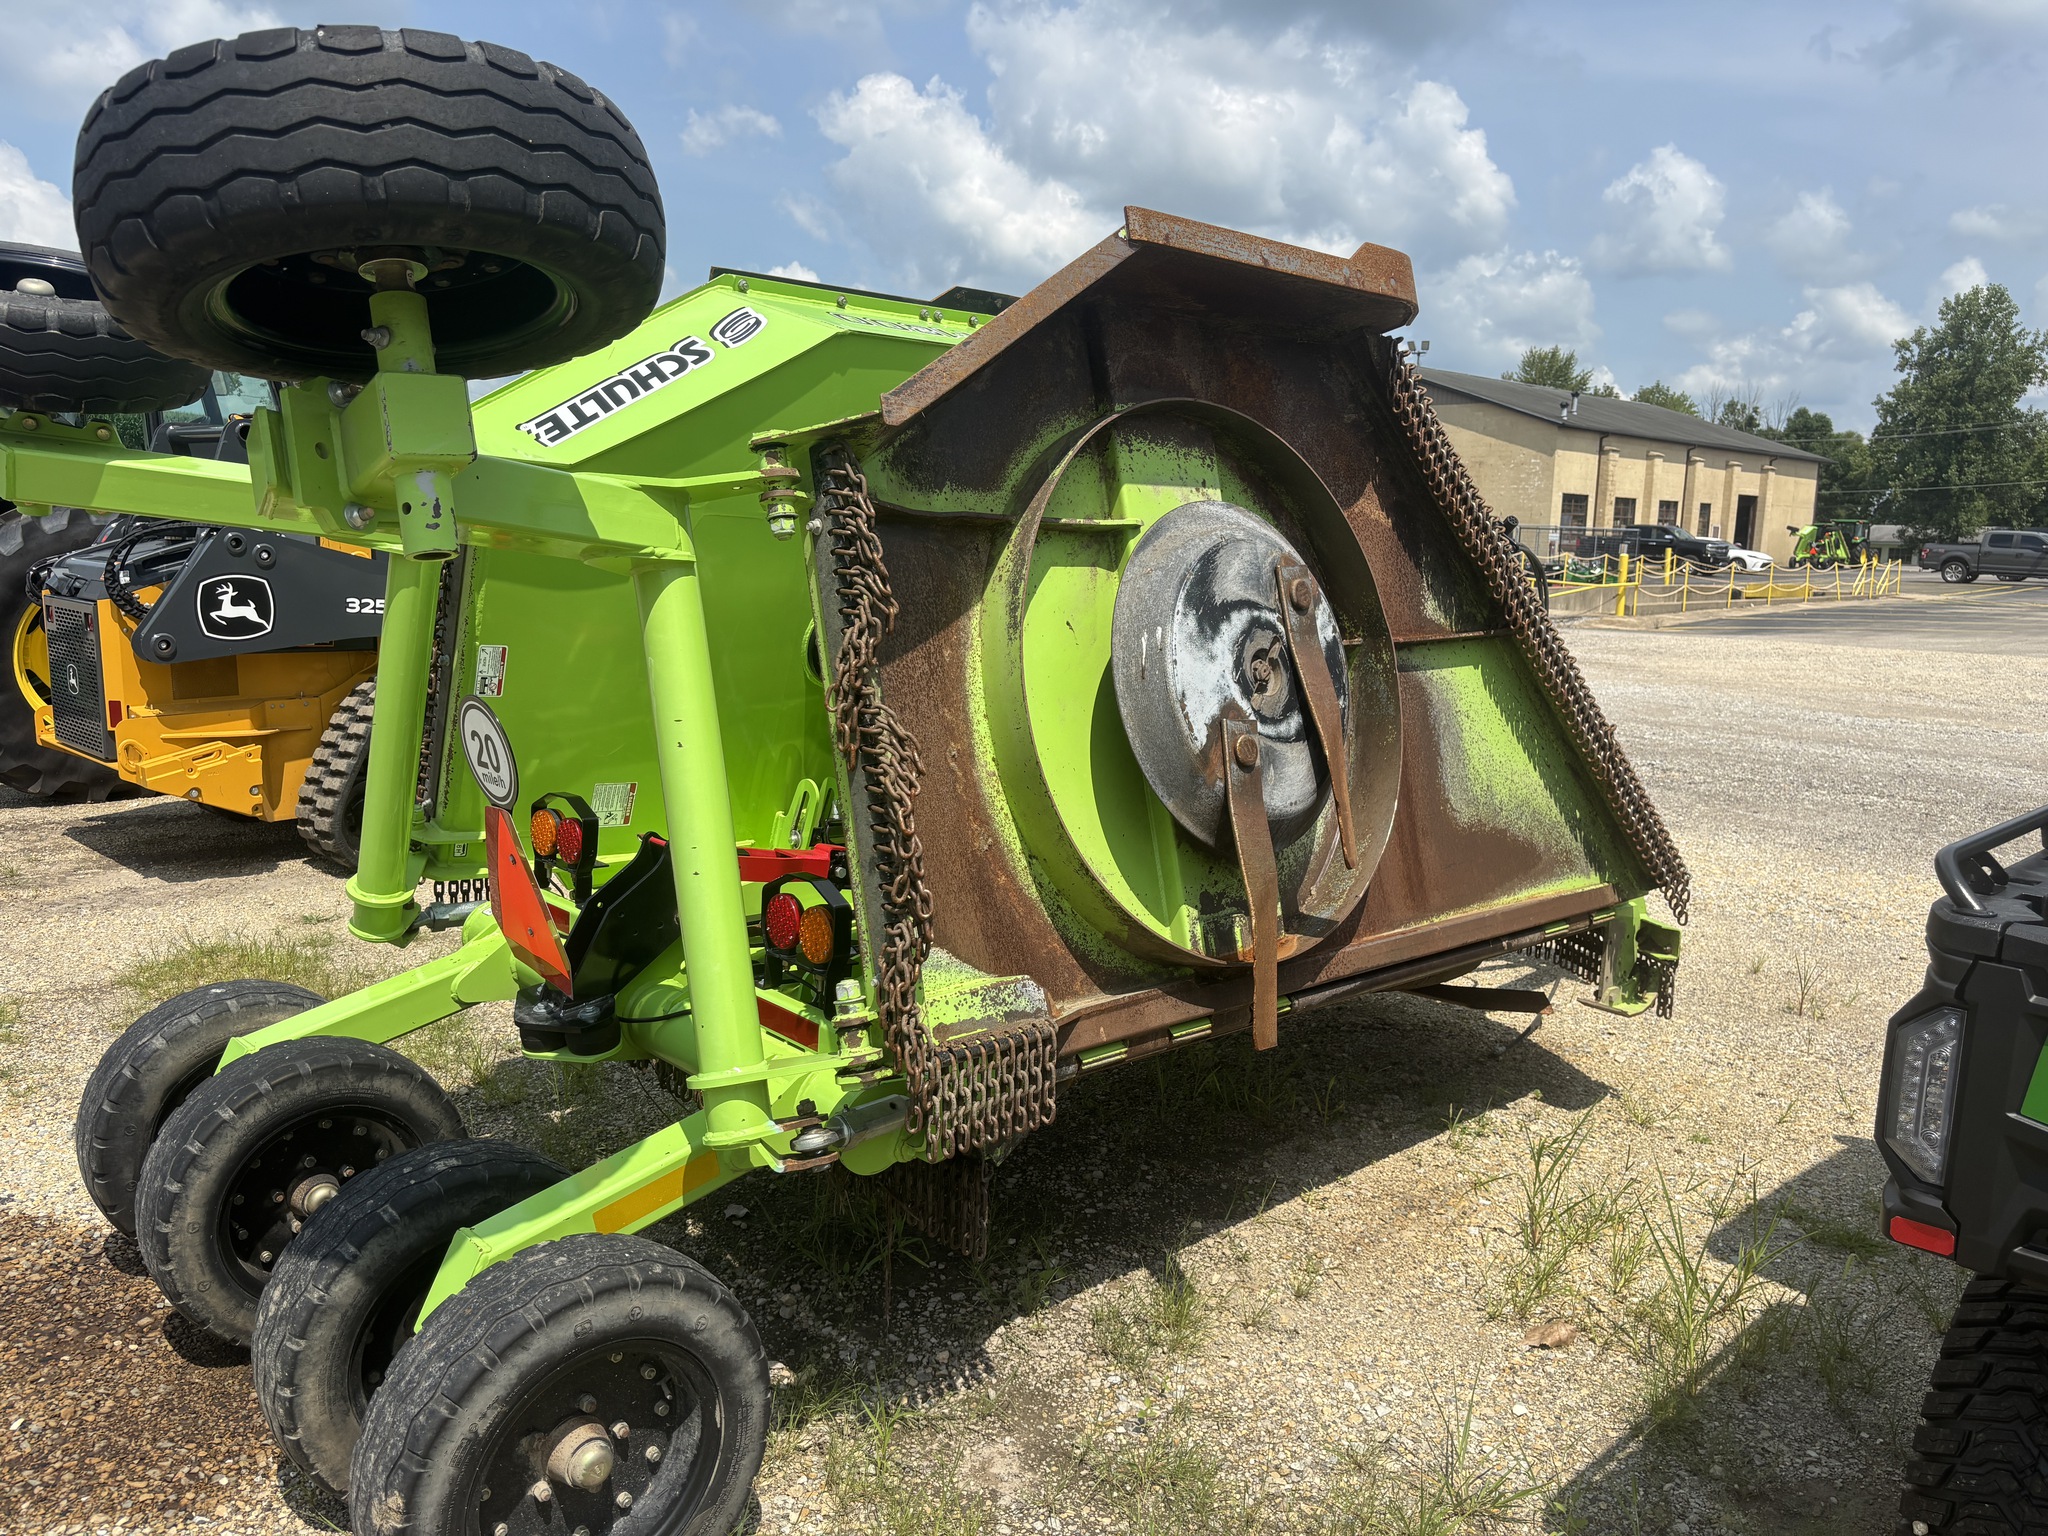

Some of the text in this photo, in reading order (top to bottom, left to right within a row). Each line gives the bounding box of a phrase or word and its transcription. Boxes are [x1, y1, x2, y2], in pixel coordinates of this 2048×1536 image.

[534, 338, 712, 444] SCHULTE
[345, 597, 386, 614] 325
[470, 729, 501, 774] 20
[481, 771, 507, 790] mile/h
